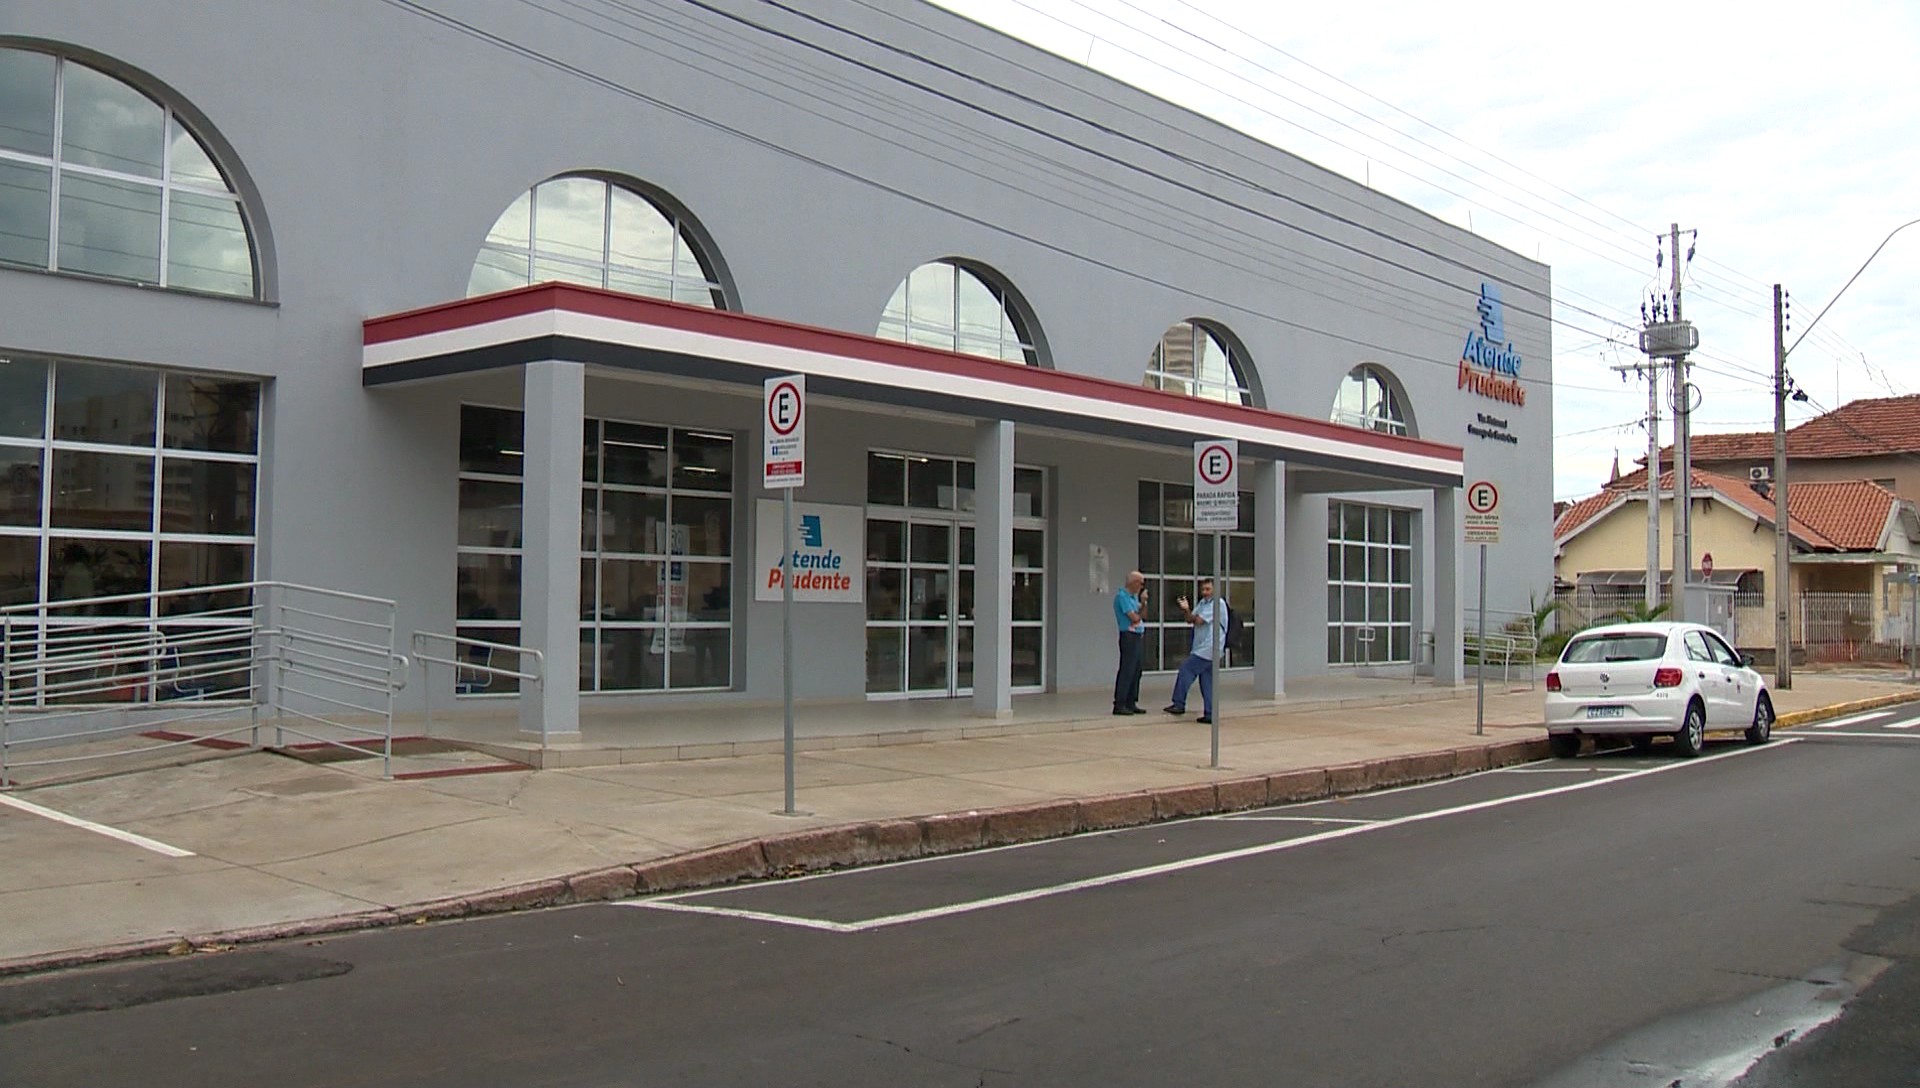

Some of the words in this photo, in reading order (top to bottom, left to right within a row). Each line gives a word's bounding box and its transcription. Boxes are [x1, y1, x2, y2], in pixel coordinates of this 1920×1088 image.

[1462, 330, 1521, 378] Atende
[1458, 360, 1526, 406] Prudente
[779, 392, 789, 424] E
[1209, 455, 1222, 475] E
[1478, 489, 1489, 507] E
